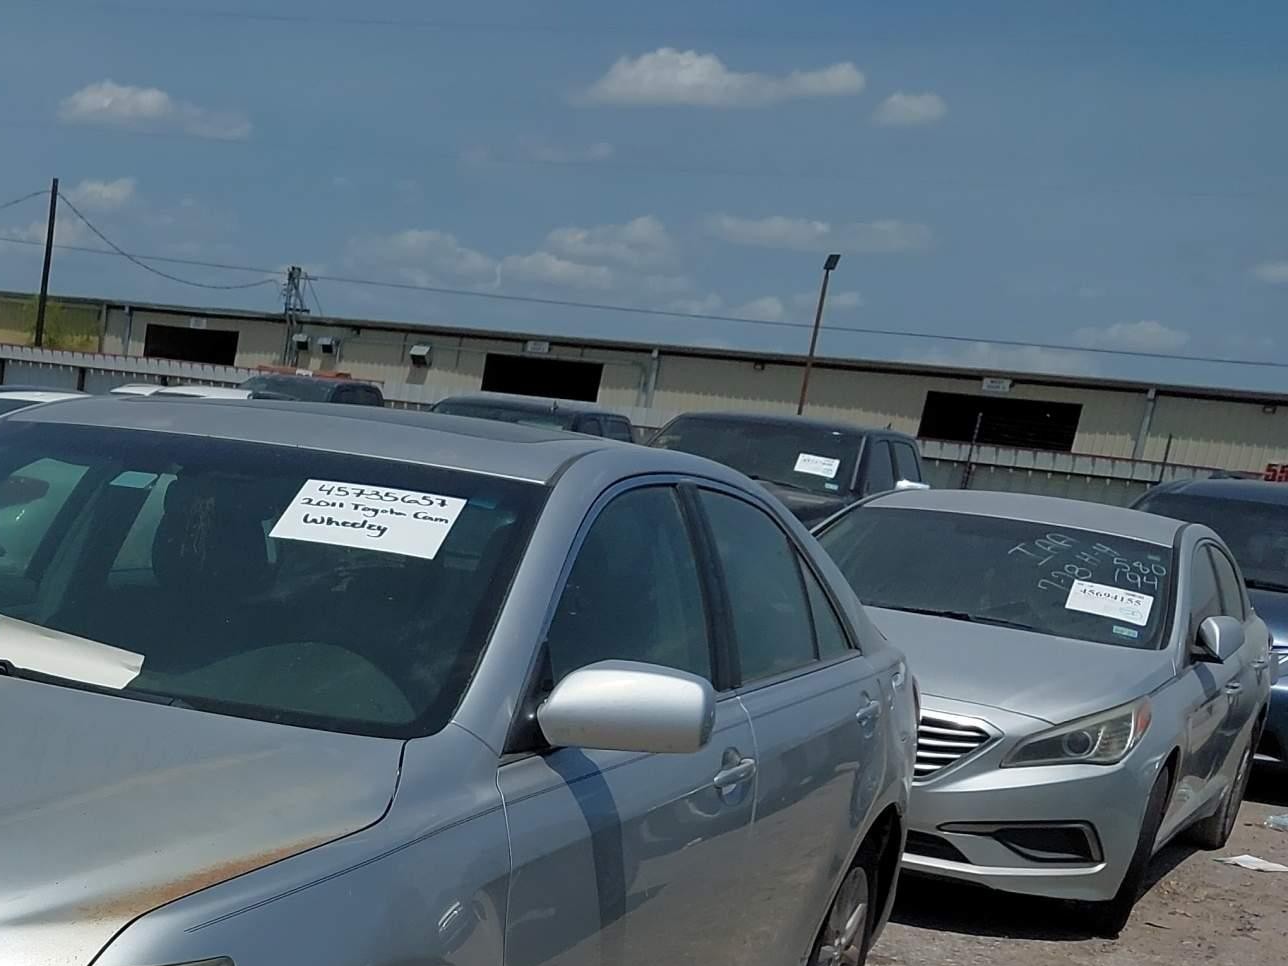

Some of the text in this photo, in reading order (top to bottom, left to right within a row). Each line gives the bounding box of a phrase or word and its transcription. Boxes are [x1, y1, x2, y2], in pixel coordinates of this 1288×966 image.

[301, 497, 345, 508] 2011
[318, 484, 449, 508] 45735657
[1113, 557, 1166, 577] 580
